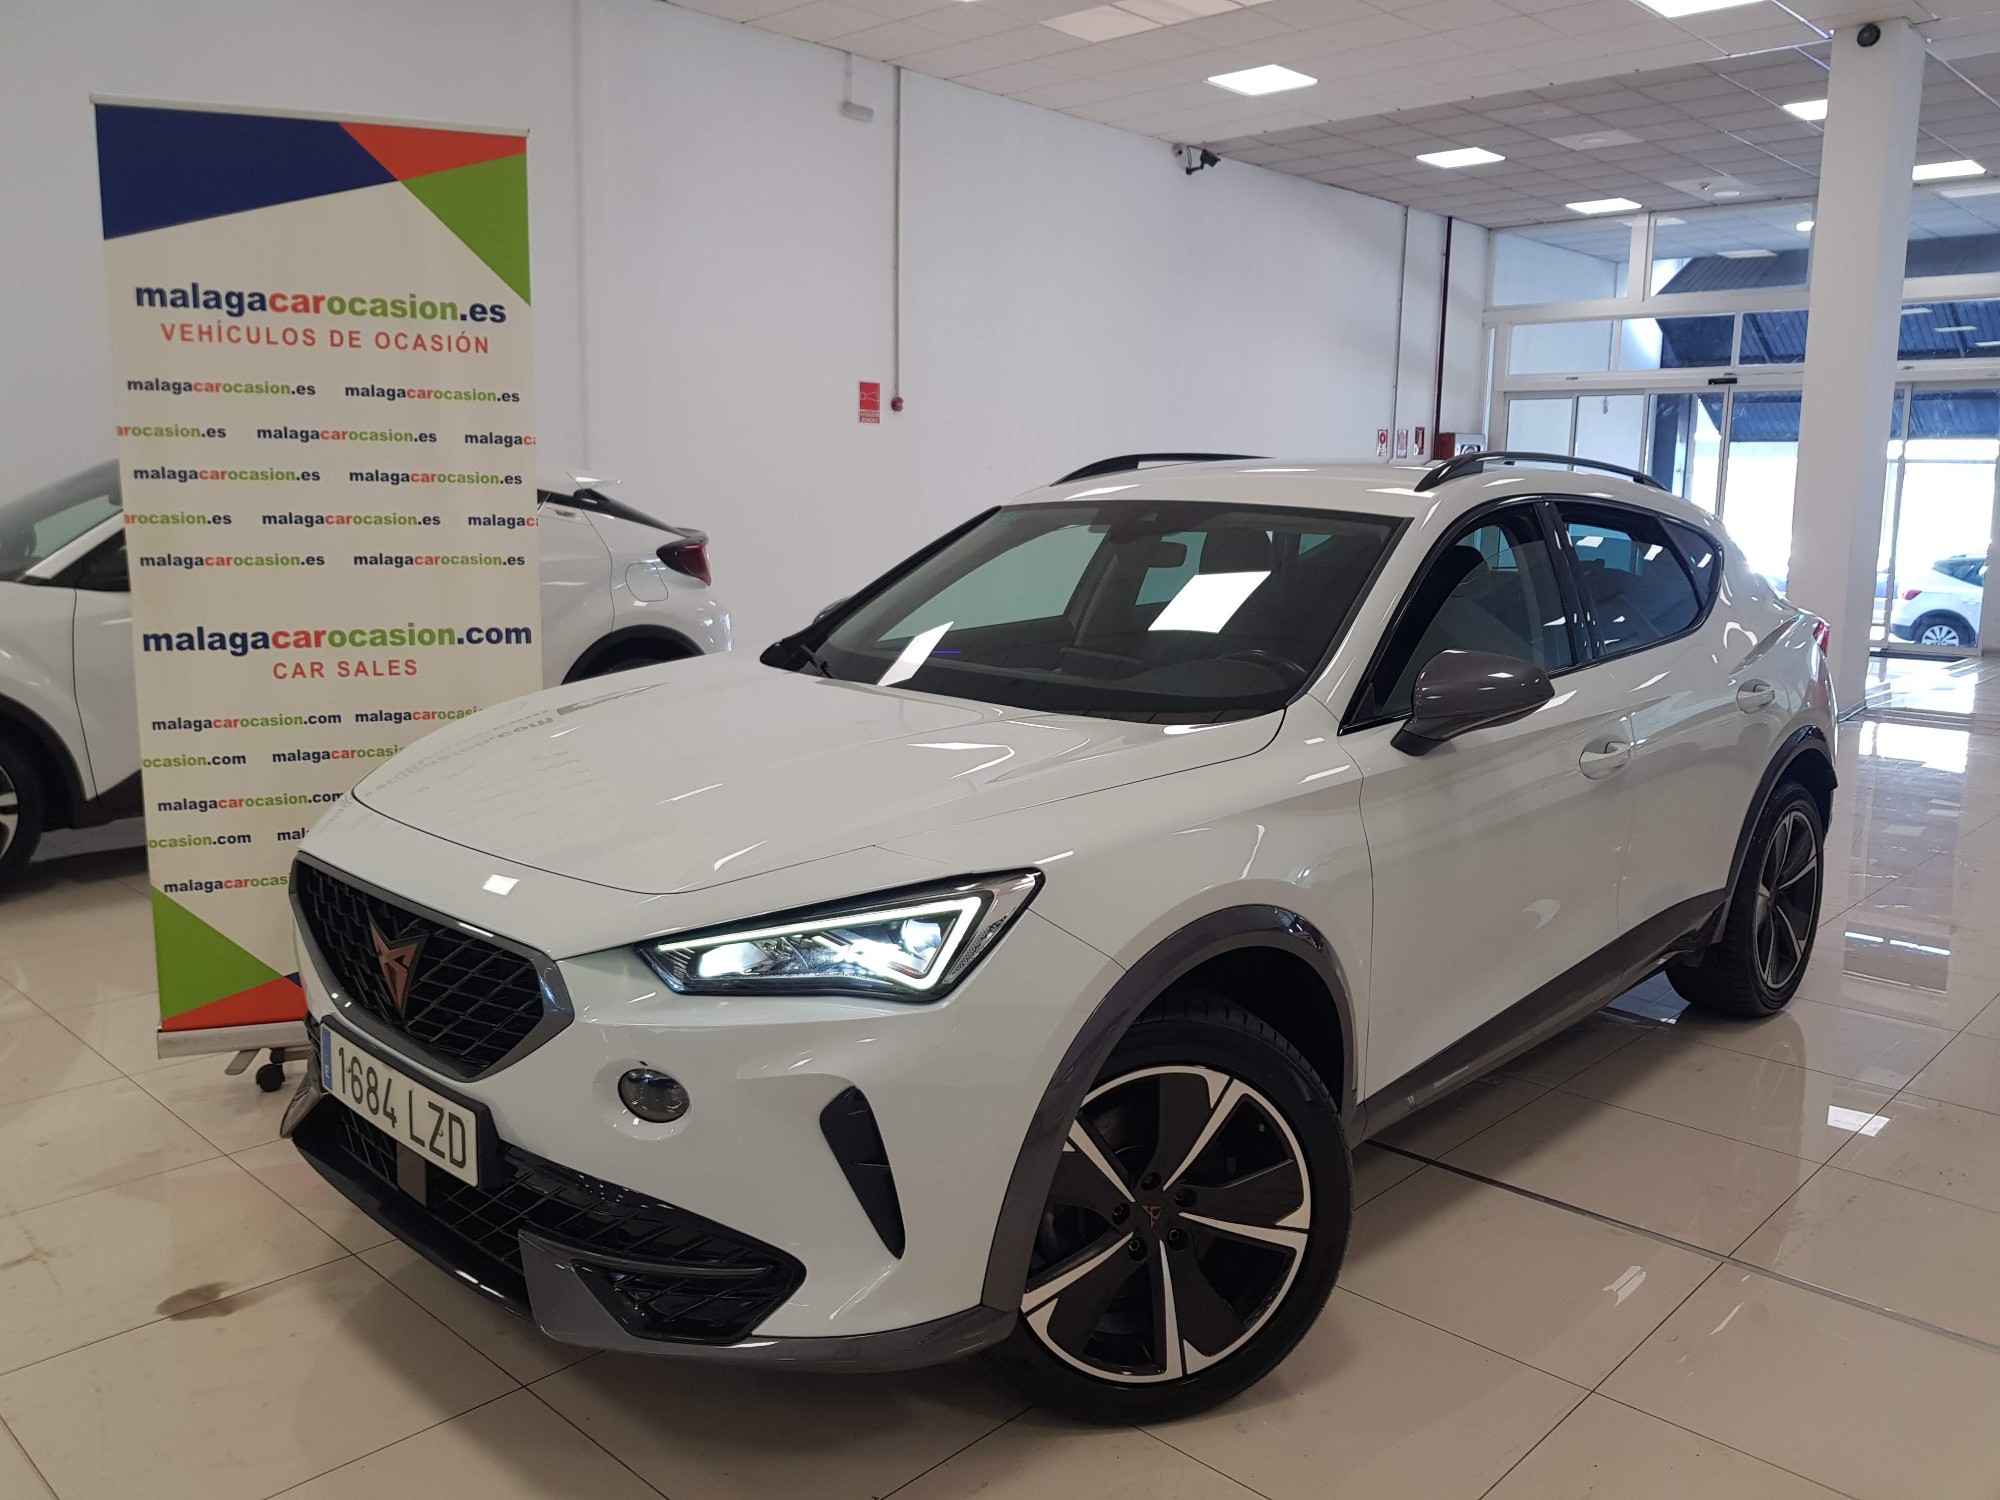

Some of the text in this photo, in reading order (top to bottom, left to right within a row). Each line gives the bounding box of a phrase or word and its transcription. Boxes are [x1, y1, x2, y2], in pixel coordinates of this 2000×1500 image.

[135, 282, 507, 323] malagacarocasion.es
[160, 320, 490, 354] VEHÍCULOS DE OCASIÓN
[127, 377, 316, 396] malagacarocasion.es
[344, 384, 520, 403] malagacarocasion.es
[256, 426, 437, 443] malagacarocasion.es
[133, 467, 320, 483] malagacarocasion.es
[349, 469, 523, 486] malagacarocasion.es
[262, 511, 441, 527] malagacarocasion.es
[468, 514, 539, 530] malagac
[140, 553, 325, 570] malagacarocasion.es
[353, 553, 526, 569] malagacarocasion.es
[142, 622, 533, 657] malagacarocasion.com
[272, 658, 418, 680] CAR SALES
[152, 712, 342, 733] malagacarocasion.com
[354, 706, 484, 724] malagacarocasi
[142, 753, 247, 768] ocasion.com
[271, 744, 404, 764] malagacarocasi
[148, 833, 252, 849] ocasion.com
[277, 827, 309, 841] mal
[338, 1047, 466, 1169] 1684 LZD
